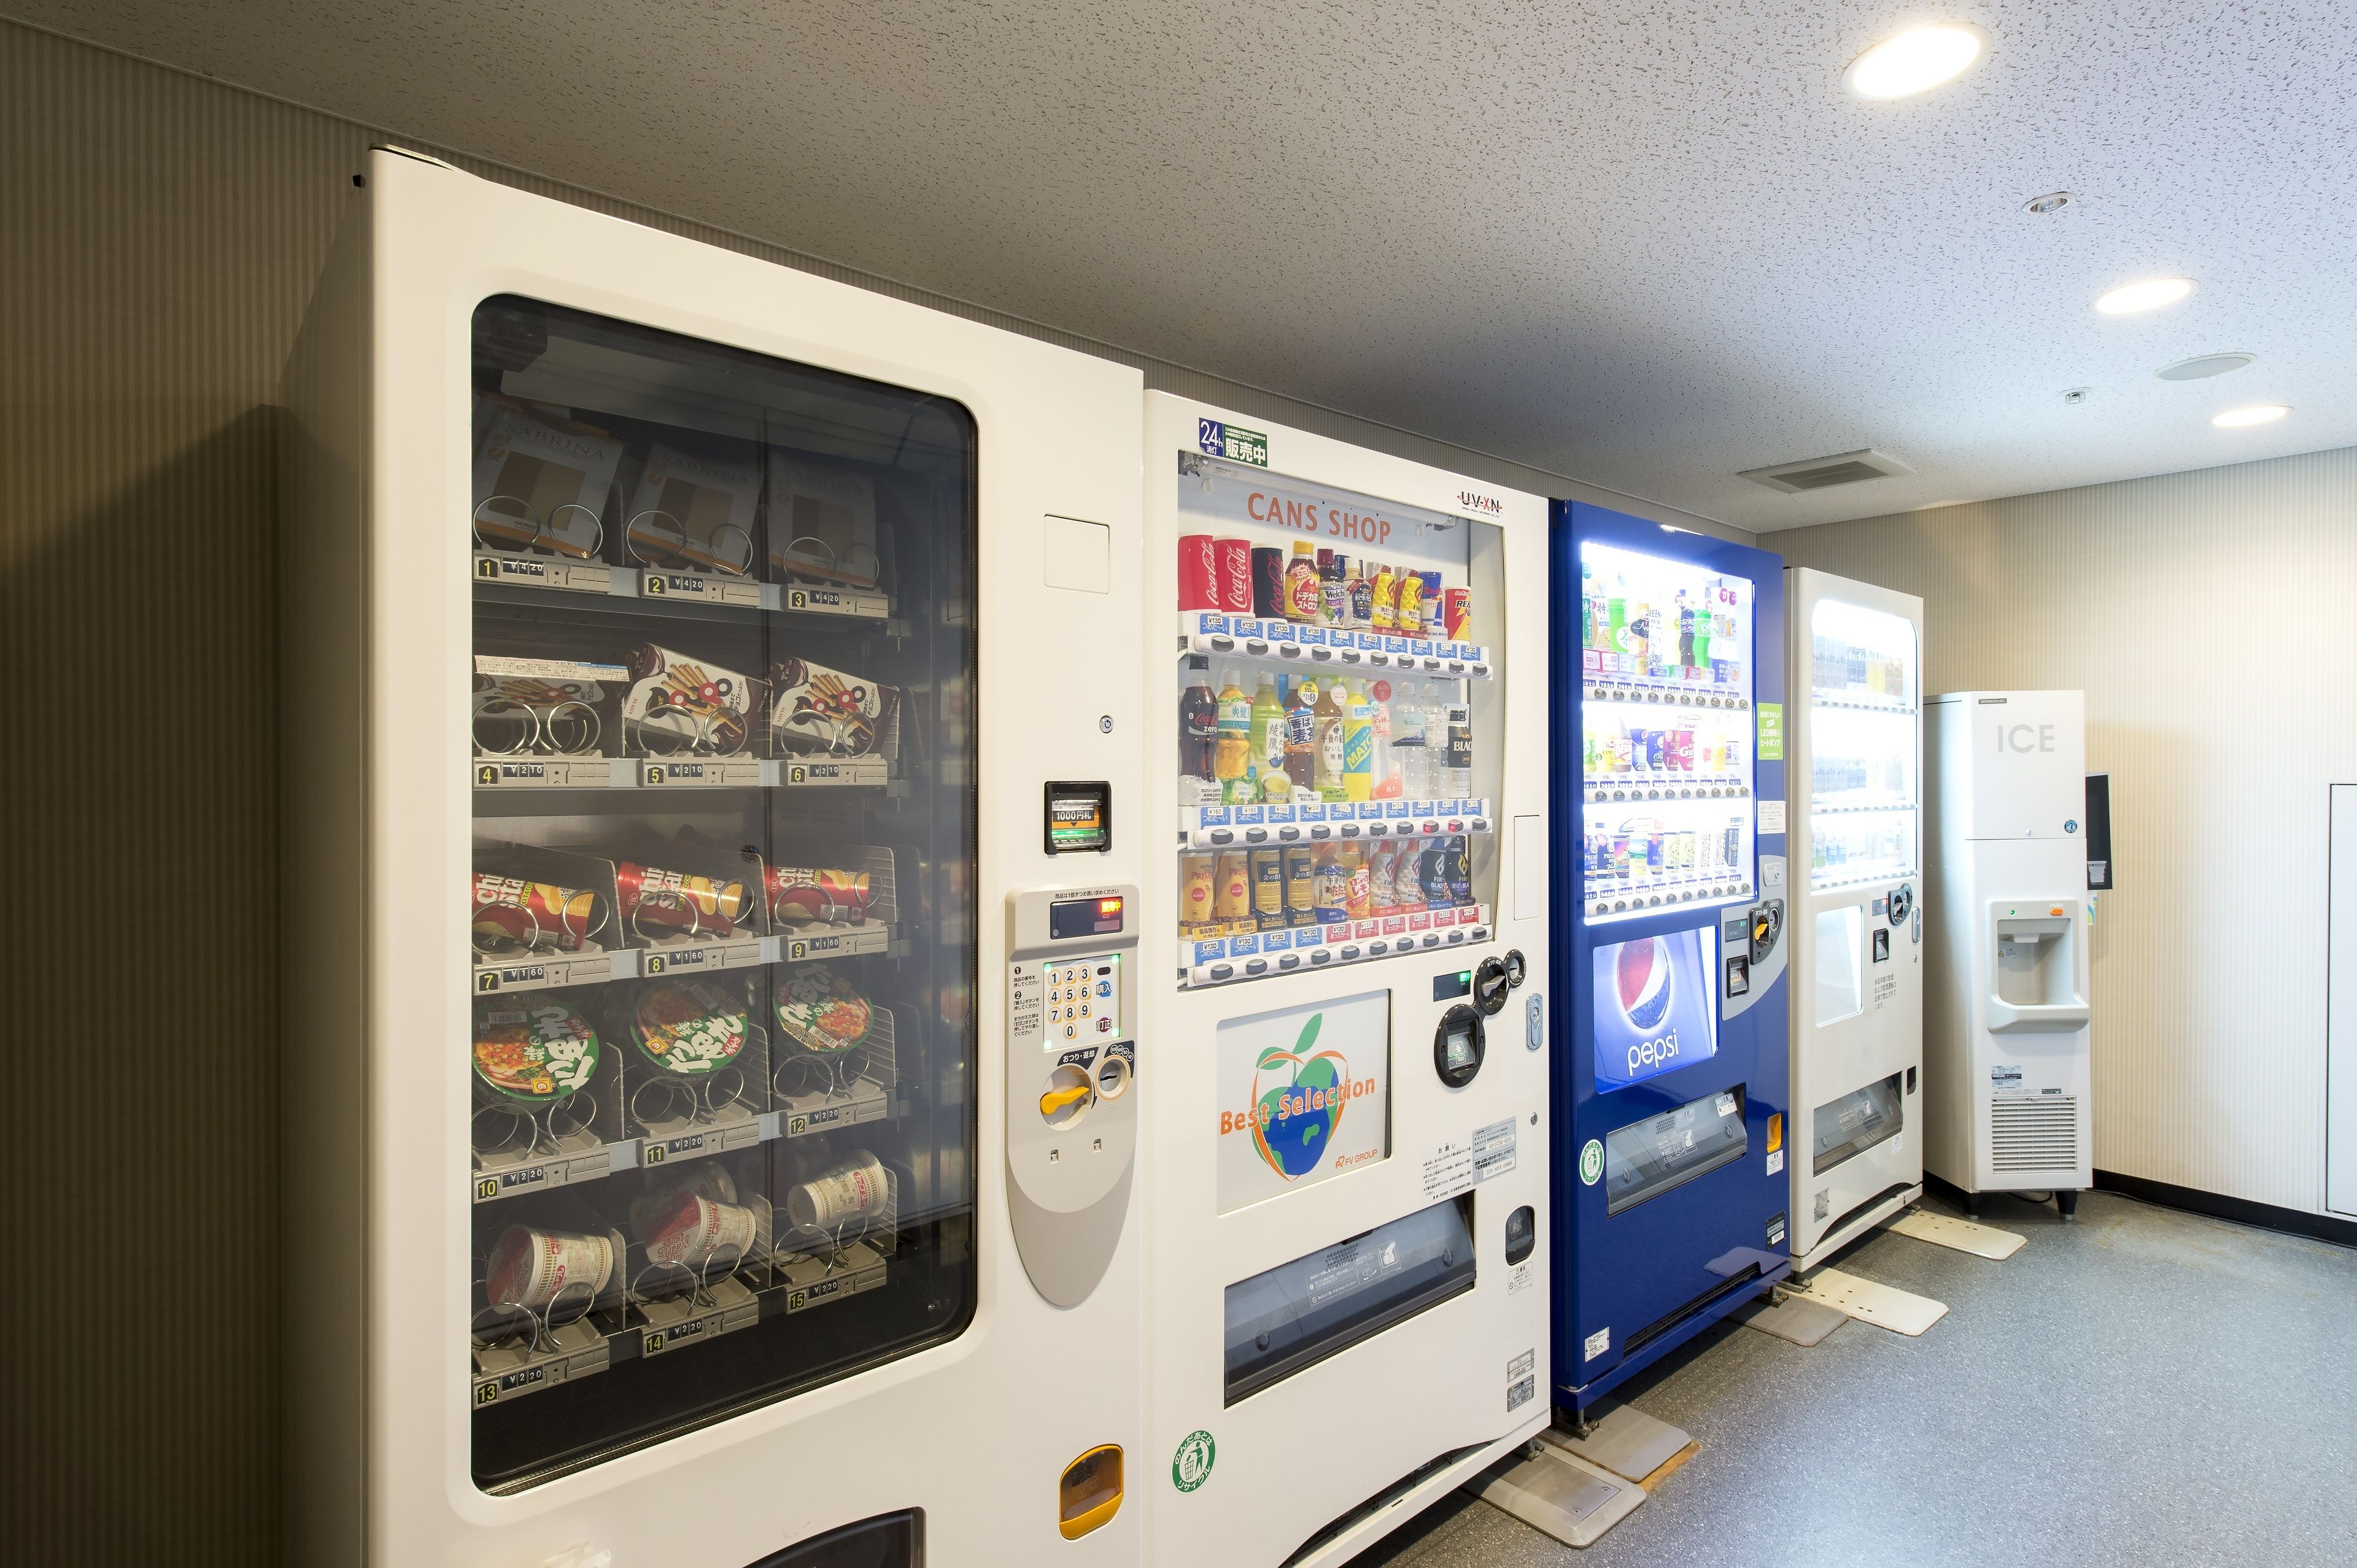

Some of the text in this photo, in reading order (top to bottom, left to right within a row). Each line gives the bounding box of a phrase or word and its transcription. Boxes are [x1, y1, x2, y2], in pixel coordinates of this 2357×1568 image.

[505, 423, 606, 460] SABRINA
[1206, 445, 1218, 455] 消灯
[1225, 438, 1266, 465] 販売中
[660, 455, 749, 485] SABRINA
[1461, 490, 1499, 513] UV-XN
[1247, 492, 1391, 545] CANS SHOP
[484, 561, 543, 576] 1 ¥420
[1226, 544, 1248, 609] Coca-Cola
[652, 578, 703, 593] 2 ¥420
[795, 593, 839, 608] 3 ¥420
[1202, 623, 1228, 632] つめた〜い
[1236, 627, 1261, 636] つめた〜い
[1269, 631, 1293, 639] つめた〜い
[1301, 634, 1323, 643] つめた〜い
[628, 697, 639, 715] LOTTE
[776, 706, 786, 723] LOTTE
[1268, 724, 1279, 751] 綾鷹
[1997, 724, 2054, 754] ICE
[482, 765, 543, 782] 4 ¥210
[651, 766, 703, 783] 5 ¥210
[794, 766, 838, 782] 6 ¥210
[1056, 810, 1091, 821] 1000円札
[629, 894, 638, 907] YBC
[1055, 889, 1120, 900] 商品は1個ずつお買い求めください
[795, 939, 838, 957] 9 ¥160
[652, 951, 703, 972] 8 ¥160
[484, 968, 543, 989] 7 ¥160
[1052, 968, 1088, 984] 1 2 3
[1051, 987, 1088, 1002] 4 5 6
[1096, 984, 1112, 995] 購入
[1013, 1003, 1040, 1011] 押してください
[1051, 1005, 1088, 1021] 7 8 9
[1013, 1013, 1039, 1022] まちがえた時は
[1096, 1019, 1112, 1032] 訂正
[676, 1019, 703, 1037] 緑の
[1067, 1025, 1073, 1037] 0
[523, 1035, 545, 1062] 緑の
[532, 1006, 595, 1090] たぬき
[665, 1014, 743, 1073] たぬき
[1627, 1027, 1679, 1076] pepsi
[1062, 1051, 1095, 1064] おつり・返却
[1220, 1077, 1376, 1135] Best Selection
[791, 1110, 838, 1133] 12 ¥220
[648, 1137, 702, 1162] 11 ¥220
[1345, 1148, 1377, 1166] FV GROUP
[479, 1168, 542, 1197] 10 ¥220
[791, 1281, 837, 1308] 15 ¥220
[647, 1321, 702, 1351] 14 ¥220
[479, 1370, 541, 1401] 13 ¥220
[1173, 1430, 1213, 1466] のんだあとは
[1177, 1463, 1212, 1491] リサイクル
